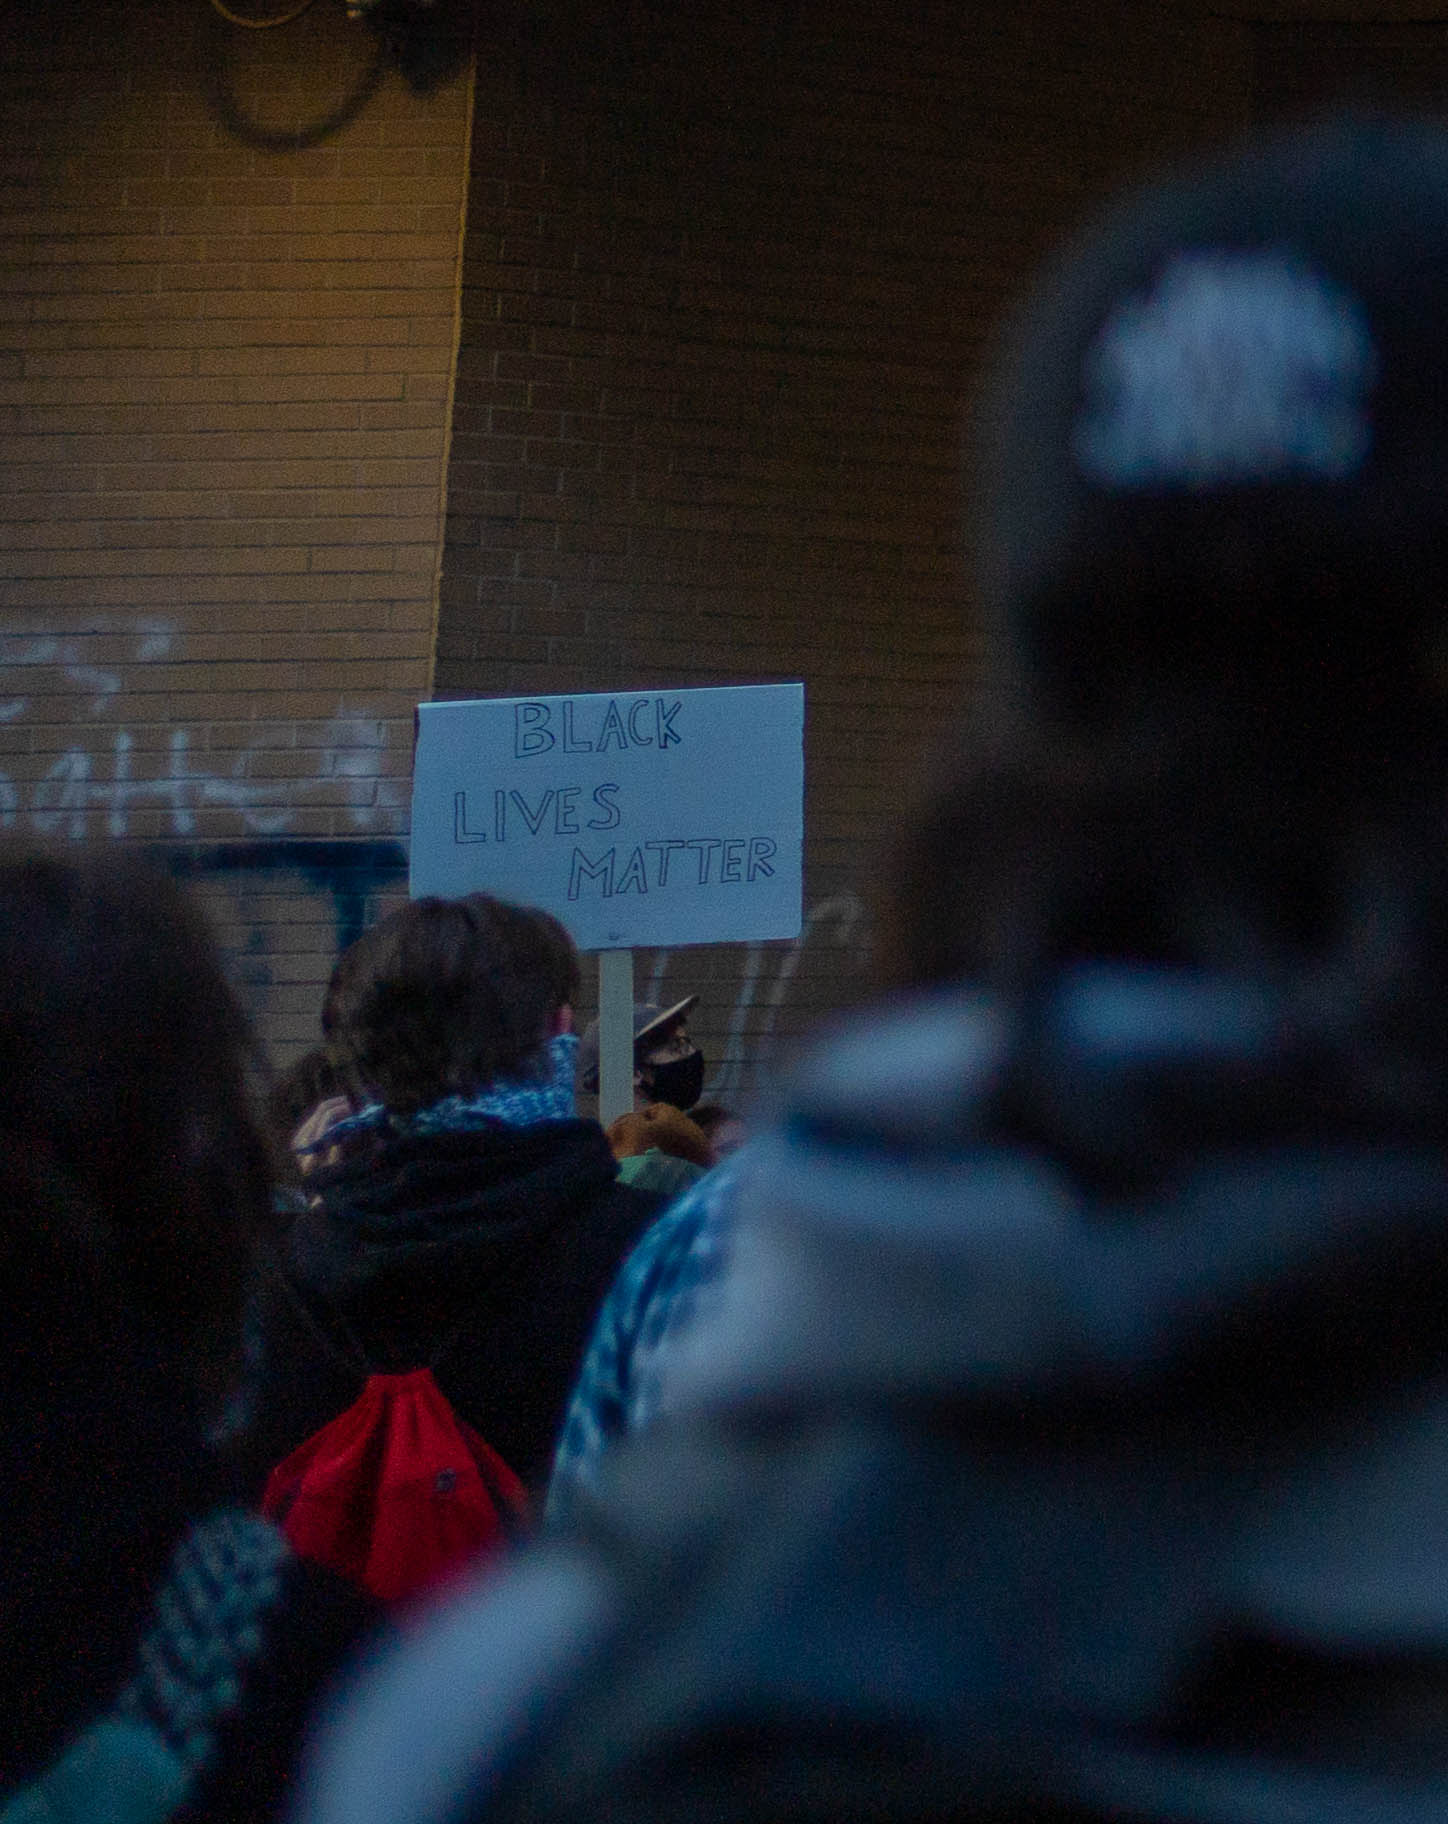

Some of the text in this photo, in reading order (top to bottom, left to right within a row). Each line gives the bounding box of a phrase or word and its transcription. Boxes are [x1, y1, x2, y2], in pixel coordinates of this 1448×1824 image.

[514, 697, 682, 759] BLACK
[454, 782, 621, 845] LIVES
[566, 836, 778, 902] MATTER
